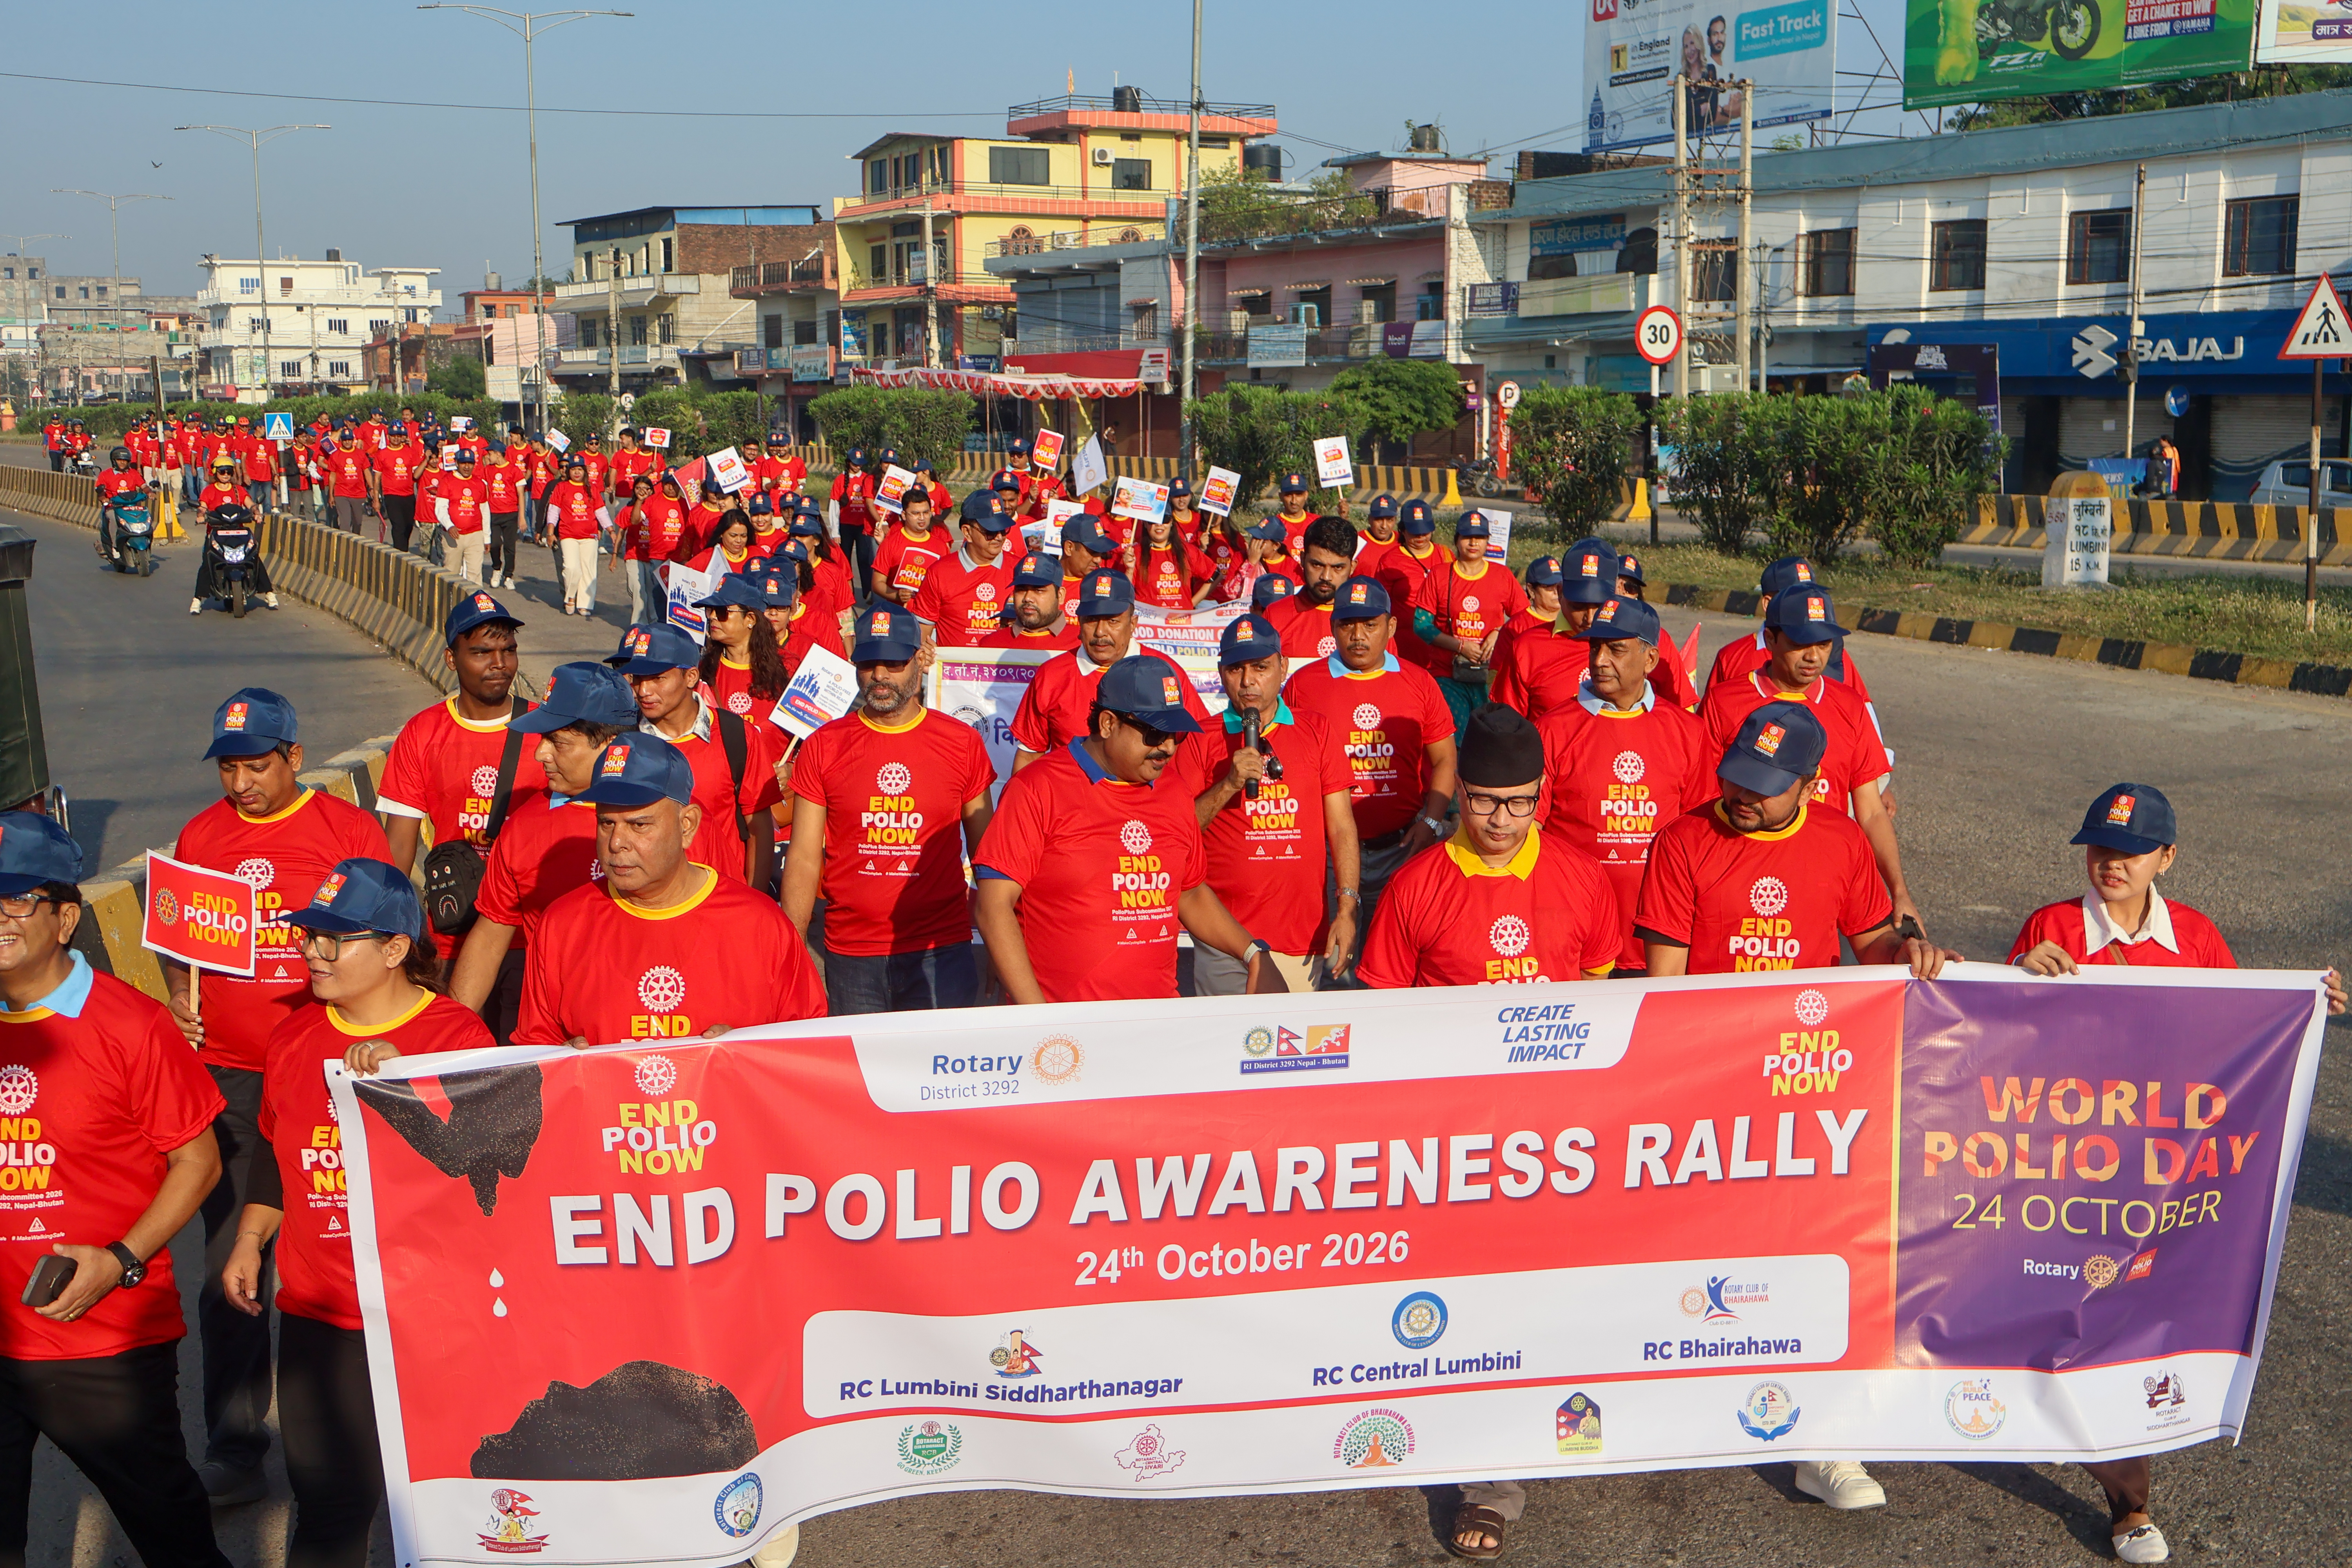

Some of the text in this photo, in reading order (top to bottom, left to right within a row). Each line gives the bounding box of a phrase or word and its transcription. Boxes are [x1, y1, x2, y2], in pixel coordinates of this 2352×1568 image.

[2127, 0, 2210, 23] GET A CHANCE TO WIN
[1742, 9, 1821, 40] Fast Track
[2127, 18, 2210, 40] A BIKE FROM YAMAHA
[2316, 25, 2341, 35] मात्र
[1639, 36, 1670, 51] England
[1648, 325, 1670, 344] 30
[2128, 336, 2244, 362] BAJAJ
[1505, 388, 1514, 403] P
[1035, 448, 1056, 460] POLIO
[1039, 444, 1054, 453] END
[1036, 455, 1052, 464] NOW
[2074, 500, 2105, 521] लुम्बिनी
[2075, 525, 2089, 537] १८
[2071, 541, 2106, 553] LUMBINI
[2071, 558, 2080, 571] 18
[1456, 619, 1485, 630] POLIO
[1459, 612, 1481, 620] END
[1158, 628, 1214, 641] DONATION
[1457, 628, 1481, 637] NOW
[1177, 646, 1208, 656] POLIO
[821, 667, 833, 677] Rotary
[824, 688, 848, 704] WITHIN REACH
[826, 684, 838, 693] WORLD
[832, 682, 851, 696] POLIO-FREE
[805, 704, 818, 714] POLIO
[818, 710, 830, 720] NOW
[869, 797, 915, 811] END
[861, 812, 923, 829] POLIO
[867, 828, 917, 844] NOW
[192, 891, 238, 915] END
[184, 904, 247, 933] POLIO
[189, 922, 240, 947] NOW
[1498, 1004, 1575, 1024] CREATE
[1503, 1022, 1590, 1044] LASTING
[1780, 1030, 1840, 1055] END
[1507, 1043, 1585, 1063] IMPACT
[933, 1054, 1022, 1076] Rotary
[1762, 1049, 1853, 1077] POLIO
[920, 1080, 1020, 1101] District 3292
[1771, 1072, 1840, 1096] NOW
[1980, 1076, 2227, 1129] WORLD
[620, 1100, 699, 1129] END
[602, 1120, 717, 1152] POLIO
[619, 1146, 705, 1175] NOW
[1924, 1131, 2259, 1185] POLIO DAY
[550, 1109, 1868, 1267] END POLIO AWARENESS RALLY
[14, 1199, 64, 1210] Nepal-Bhutan
[1952, 1190, 2221, 1238] 24 OCTOBER
[16, 1231, 65, 1241] MakeWalkingSafe
[1075, 1230, 1410, 1286] 24th October 2026
[2024, 1259, 2080, 1280] Rotary
[1725, 1283, 1769, 1294] ROTARY CLUB OF
[1725, 1294, 1769, 1304] BHAIRAHAWA
[1644, 1336, 1802, 1361] RC Bhairahawa
[1313, 1350, 1521, 1387] RC Central Lumbini
[840, 1378, 1183, 1403] RC Lumbini Siddharthanagar
[2156, 1406, 2181, 1416] ROTARACT
[2147, 1417, 2190, 1431] SIDDHARTHANAGAR
[1334, 1427, 1348, 1459] ROTARACT
[1346, 1415, 1361, 1428] CLUB
[1371, 1408, 1407, 1426] BHAIRAHAWA
[1405, 1424, 1415, 1454] CHAUTARI
[904, 1467, 925, 1475] GREEN,
[944, 1457, 961, 1470] CLEAN
[745, 1474, 760, 1485] Central
[492, 1490, 511, 1499] ROTARACT
[720, 1483, 735, 1497] Club
[716, 1500, 730, 1532] Rotaract
[486, 1541, 498, 1550] Rotaract
